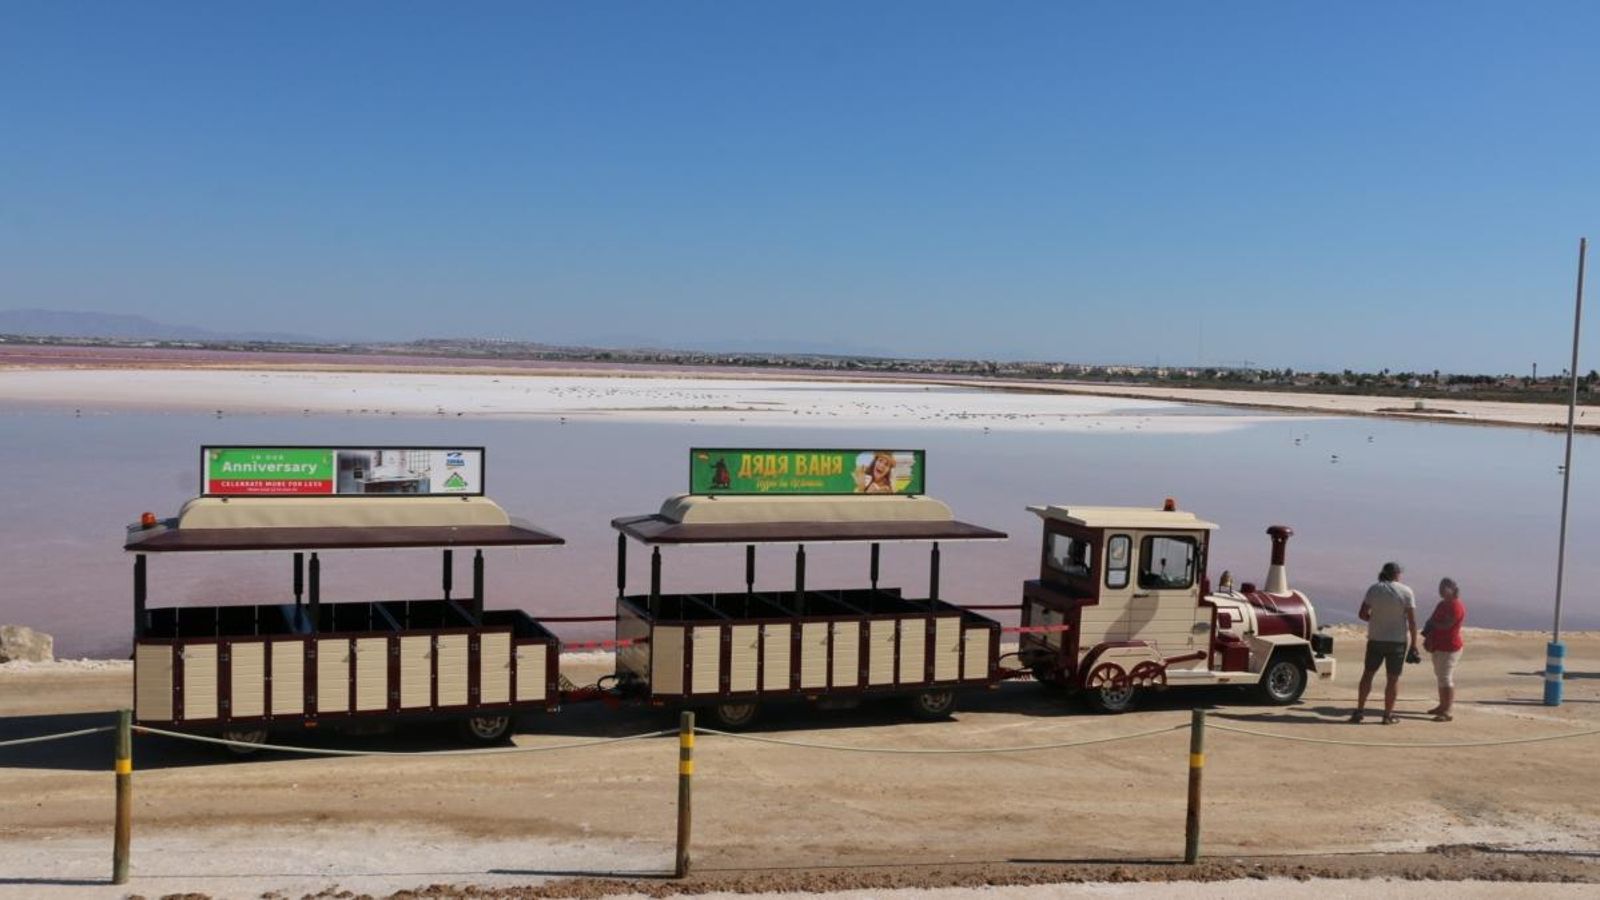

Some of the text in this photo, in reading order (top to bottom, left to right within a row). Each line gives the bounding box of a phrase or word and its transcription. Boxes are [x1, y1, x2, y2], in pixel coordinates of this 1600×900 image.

[222, 461, 318, 475] Anniversary
[738, 454, 843, 478] ДЯДЯ ВАНЯ
